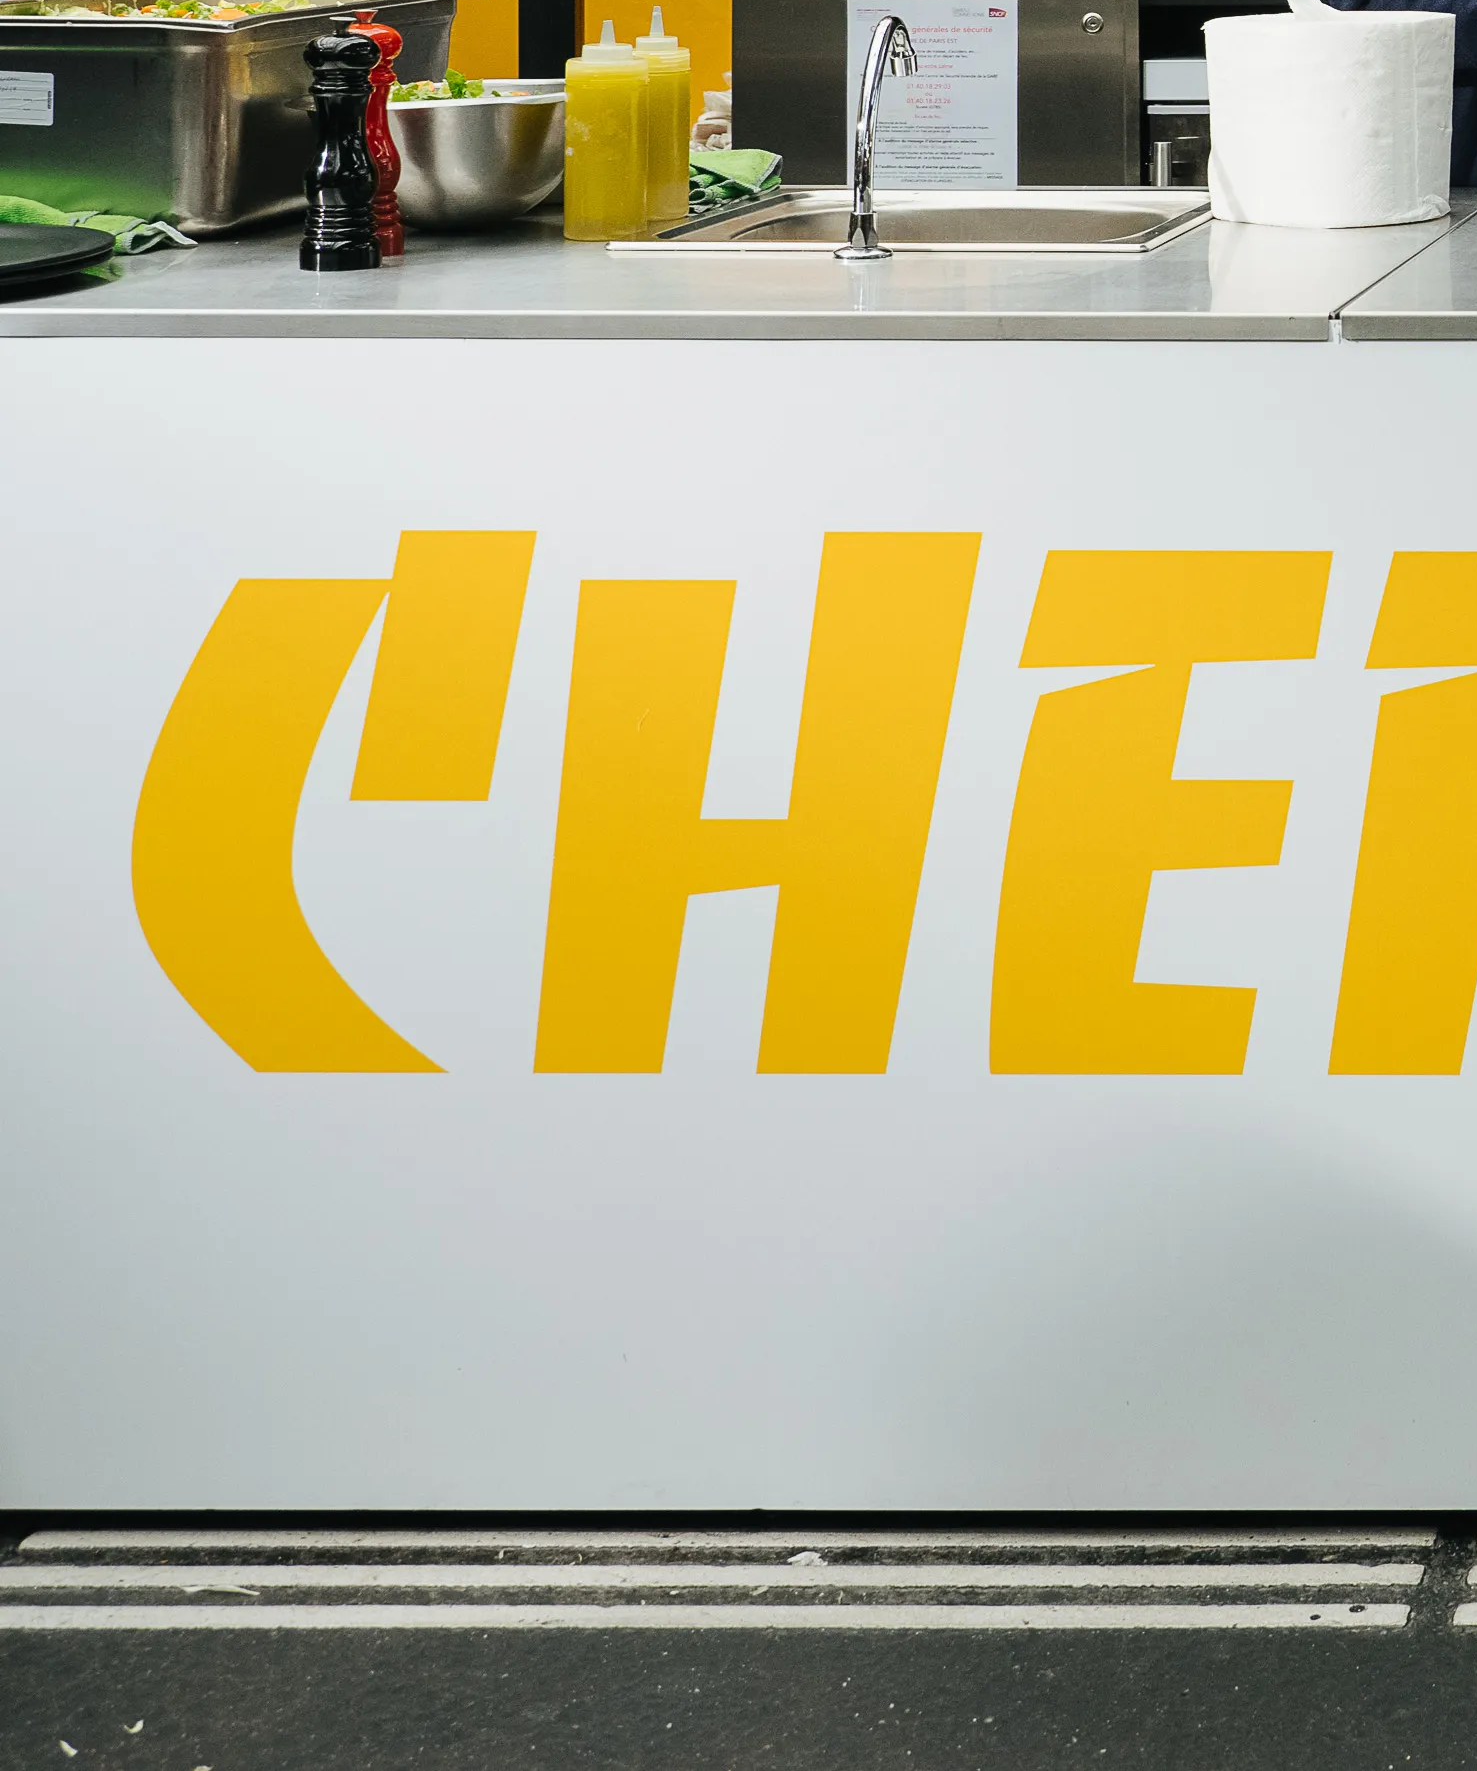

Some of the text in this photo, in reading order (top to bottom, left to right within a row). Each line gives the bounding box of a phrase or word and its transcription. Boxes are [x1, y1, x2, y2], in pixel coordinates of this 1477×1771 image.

[912, 25, 993, 34] générales de sécurité
